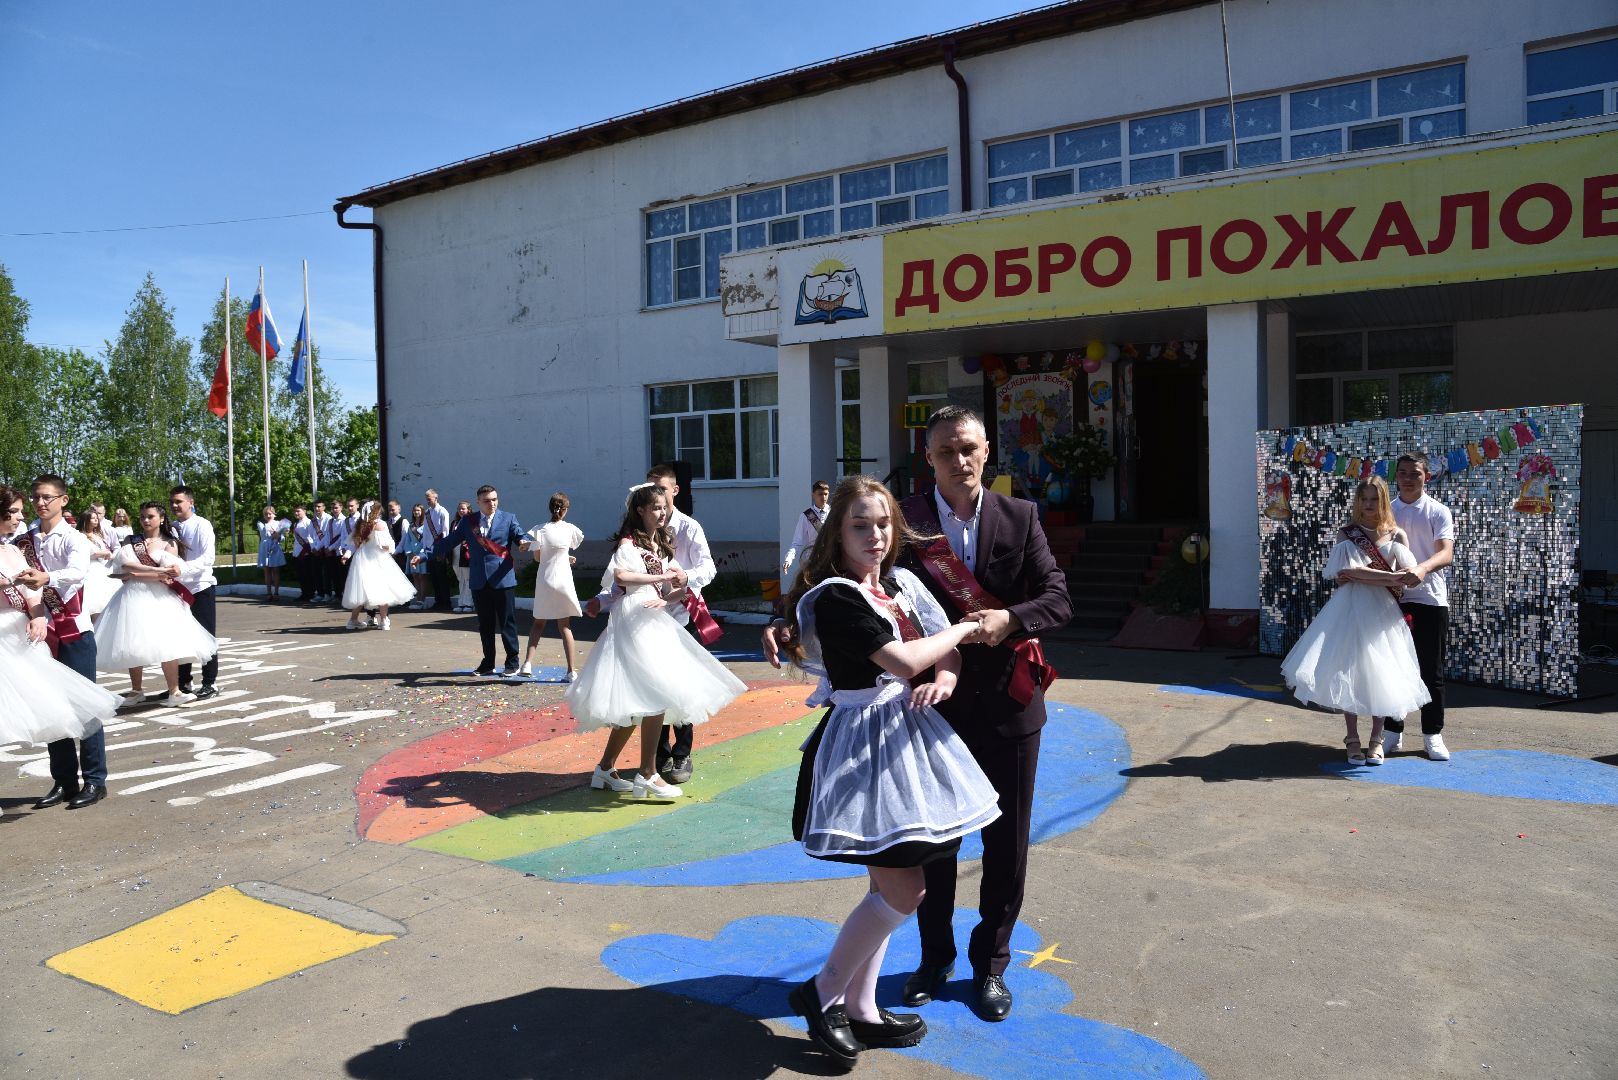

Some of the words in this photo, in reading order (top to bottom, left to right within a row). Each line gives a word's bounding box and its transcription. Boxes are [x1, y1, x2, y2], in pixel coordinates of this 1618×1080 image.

[895, 236, 1132, 317] ДОБРО
[998, 374, 1041, 398] ПОСЛЕДНИЙ
[1043, 374, 1072, 392] ЗВОНОК
